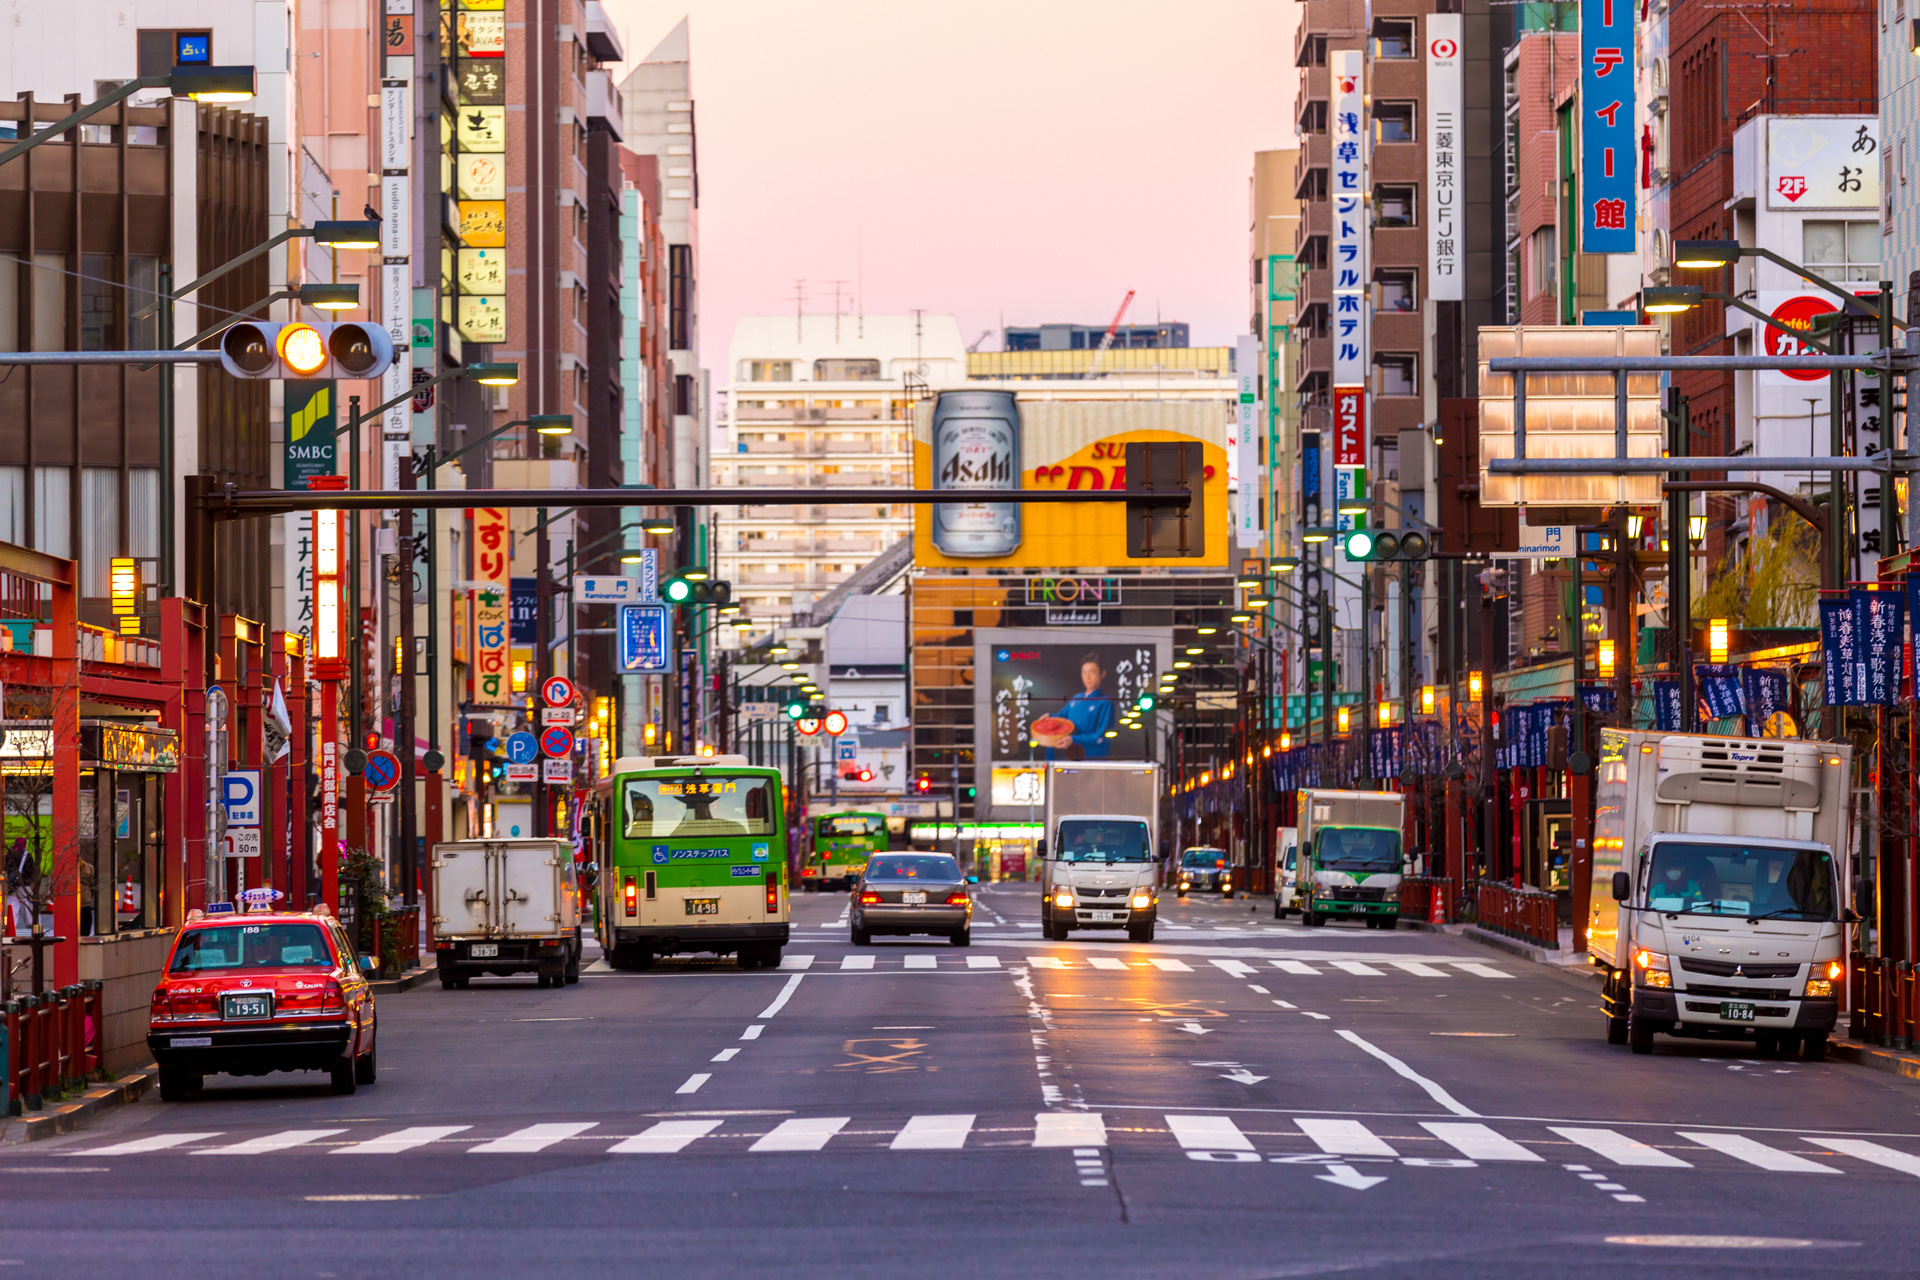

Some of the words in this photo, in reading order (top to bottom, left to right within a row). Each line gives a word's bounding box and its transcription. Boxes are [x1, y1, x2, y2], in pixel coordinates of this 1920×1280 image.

[182, 43, 205, 55] 占い
[1780, 177, 1804, 194] 2F
[391, 182, 400, 210] studio
[1436, 112, 1455, 275] 三菱東京UFJ銀行
[391, 212, 400, 250] nana-iro
[1337, 112, 1360, 361] 浅草セントラルホテル
[1339, 396, 1358, 450] ガスト
[288, 445, 333, 459] SMBC
[1340, 453, 1358, 463] 2F
[941, 451, 1011, 483] Asahi
[1029, 578, 1117, 601] FRONT
[1050, 600, 1098, 621] asakusa
[1869, 600, 1887, 700] 新春浅草歌舞伎
[479, 620, 505, 698] ぱぱす
[322, 742, 337, 829] 雷門東部商店会
[685, 782, 737, 794] 浅草雷門
[238, 833, 259, 841] この先
[238, 844, 258, 853] 50m
[671, 849, 730, 859] ノンステップバス
[247, 892, 270, 901] チェッカー
[692, 903, 718, 914] 14-98
[242, 926, 260, 934] 188
[235, 1003, 265, 1015] 19-51
[1728, 1008, 1754, 1020] 10-84
